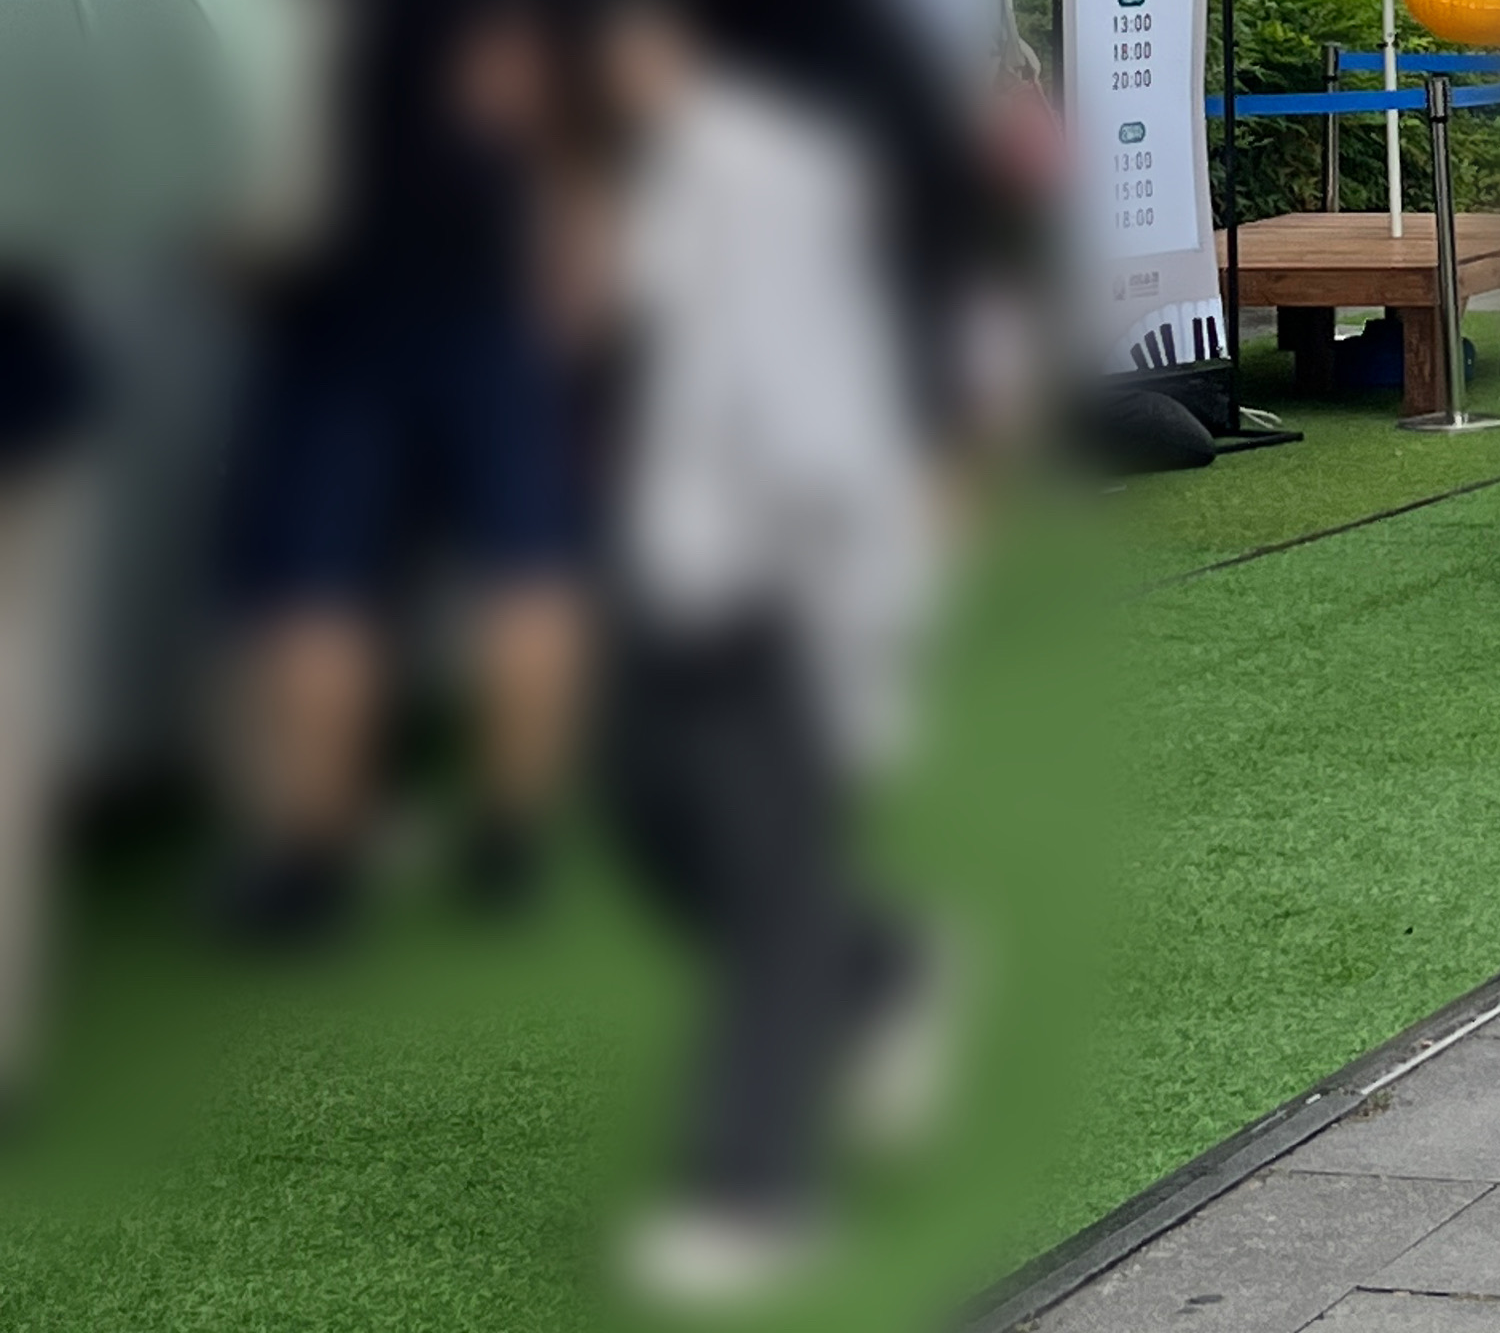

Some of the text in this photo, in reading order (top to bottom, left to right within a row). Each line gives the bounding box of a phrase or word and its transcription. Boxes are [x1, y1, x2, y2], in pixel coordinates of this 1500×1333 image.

[1113, 13, 1152, 33] 13:00
[1113, 41, 1152, 61] 18:00
[1112, 69, 1152, 90] 20:00
[1114, 151, 1152, 173] 13:00
[1115, 179, 1153, 201] 15:00
